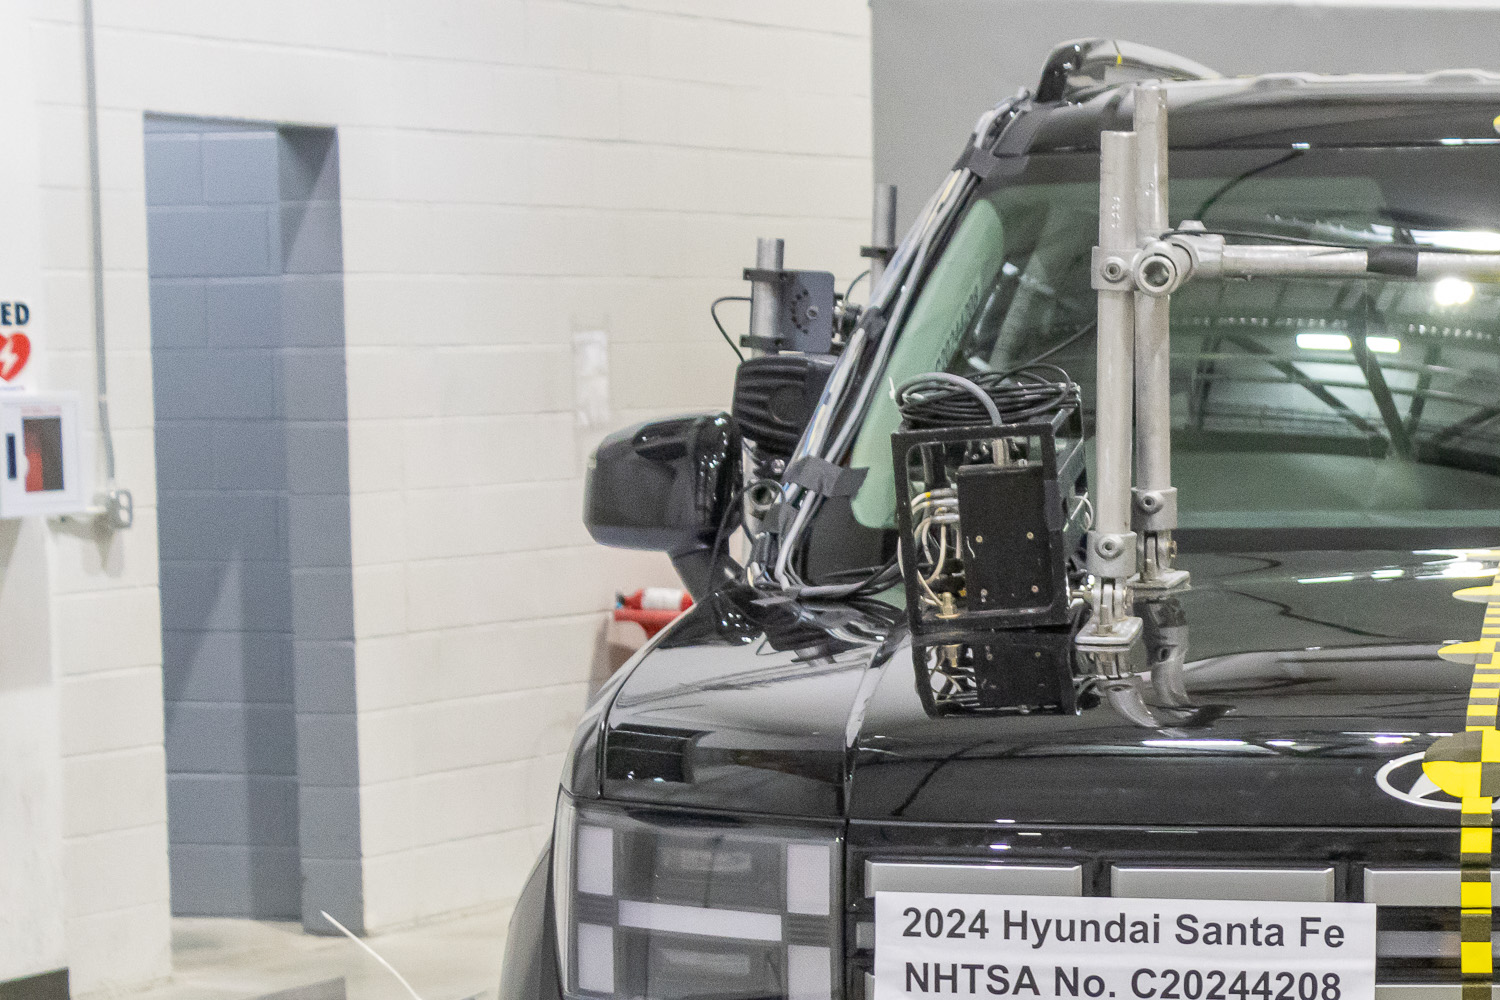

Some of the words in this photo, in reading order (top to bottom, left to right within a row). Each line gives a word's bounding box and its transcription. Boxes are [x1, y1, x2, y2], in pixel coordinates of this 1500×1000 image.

[0, 302, 30, 326] ED
[902, 907, 989, 939] 2024
[1003, 909, 1160, 949] Hyundai
[1174, 913, 1285, 947] Santa
[1300, 916, 1345, 948] Fe
[905, 962, 1041, 996] NHTSA
[1054, 966, 1116, 998] No.
